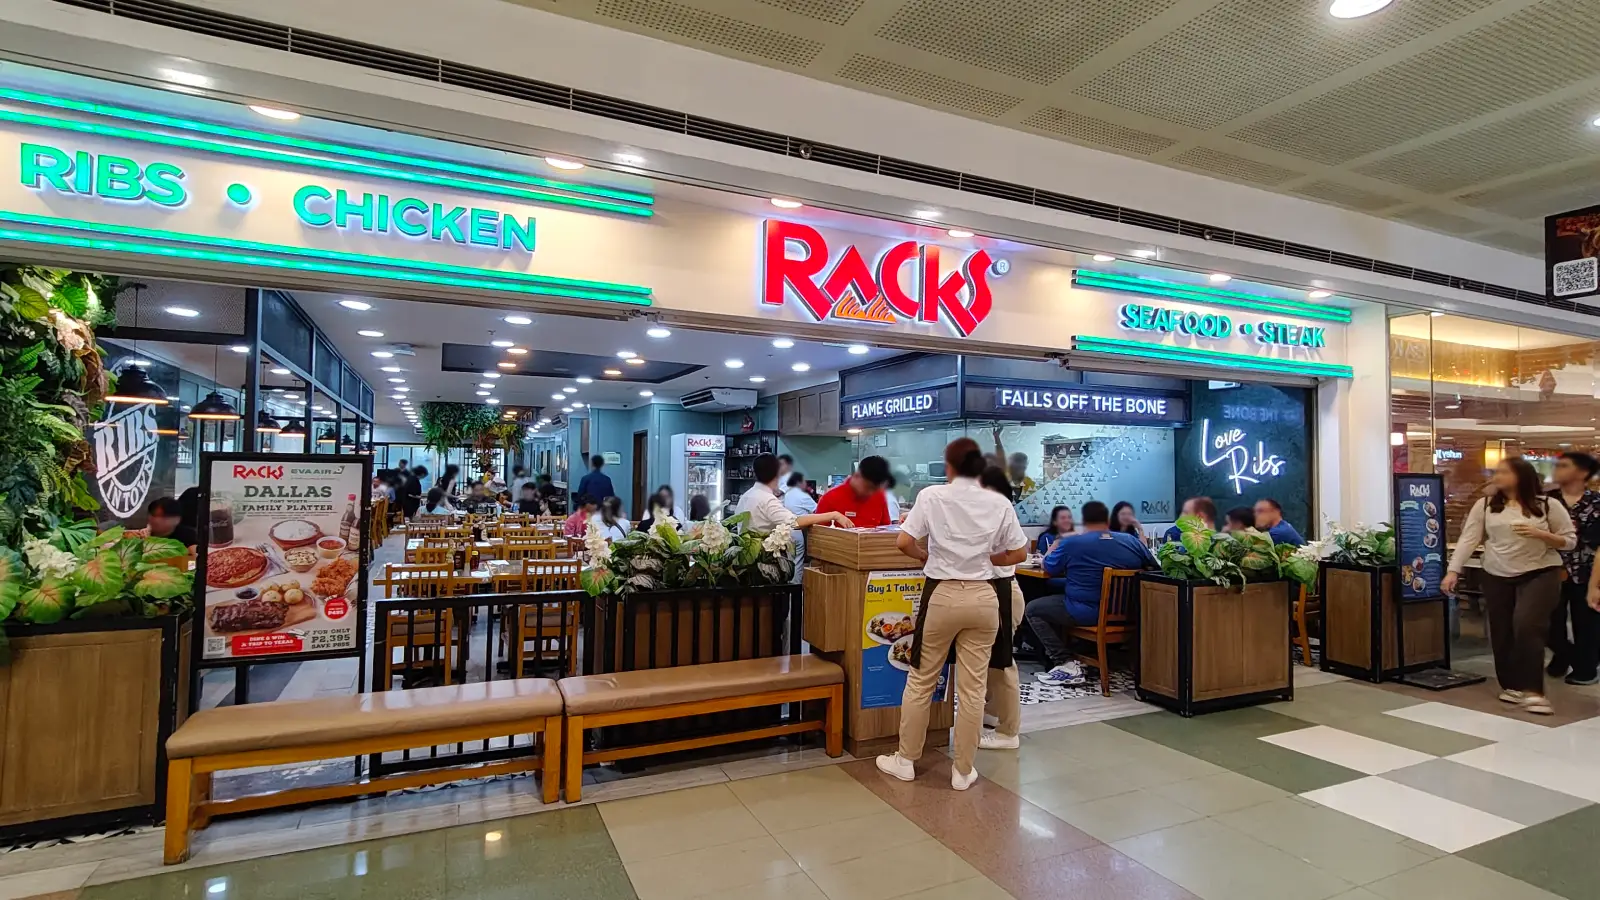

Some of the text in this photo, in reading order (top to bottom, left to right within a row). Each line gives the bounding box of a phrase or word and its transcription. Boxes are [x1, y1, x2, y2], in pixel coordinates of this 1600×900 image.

[20, 142, 537, 252] RIBS CHICKEN
[762, 218, 993, 337] RACKS
[1120, 303, 1326, 348] SEAFOOD STEAK
[852, 395, 933, 419] FLAME GRILLED
[1002, 390, 1166, 415] FALLS OFF THE BONE
[94, 403, 159, 479] RIBS
[688, 438, 712, 448] RACKS
[1202, 418, 1247, 467] Love
[233, 465, 285, 480] RACKS
[1226, 441, 1287, 495] Ribs
[244, 485, 333, 498] DALLAS
[1142, 500, 1170, 515] RACKS
[868, 583, 922, 594] Buy 1 Take 1
